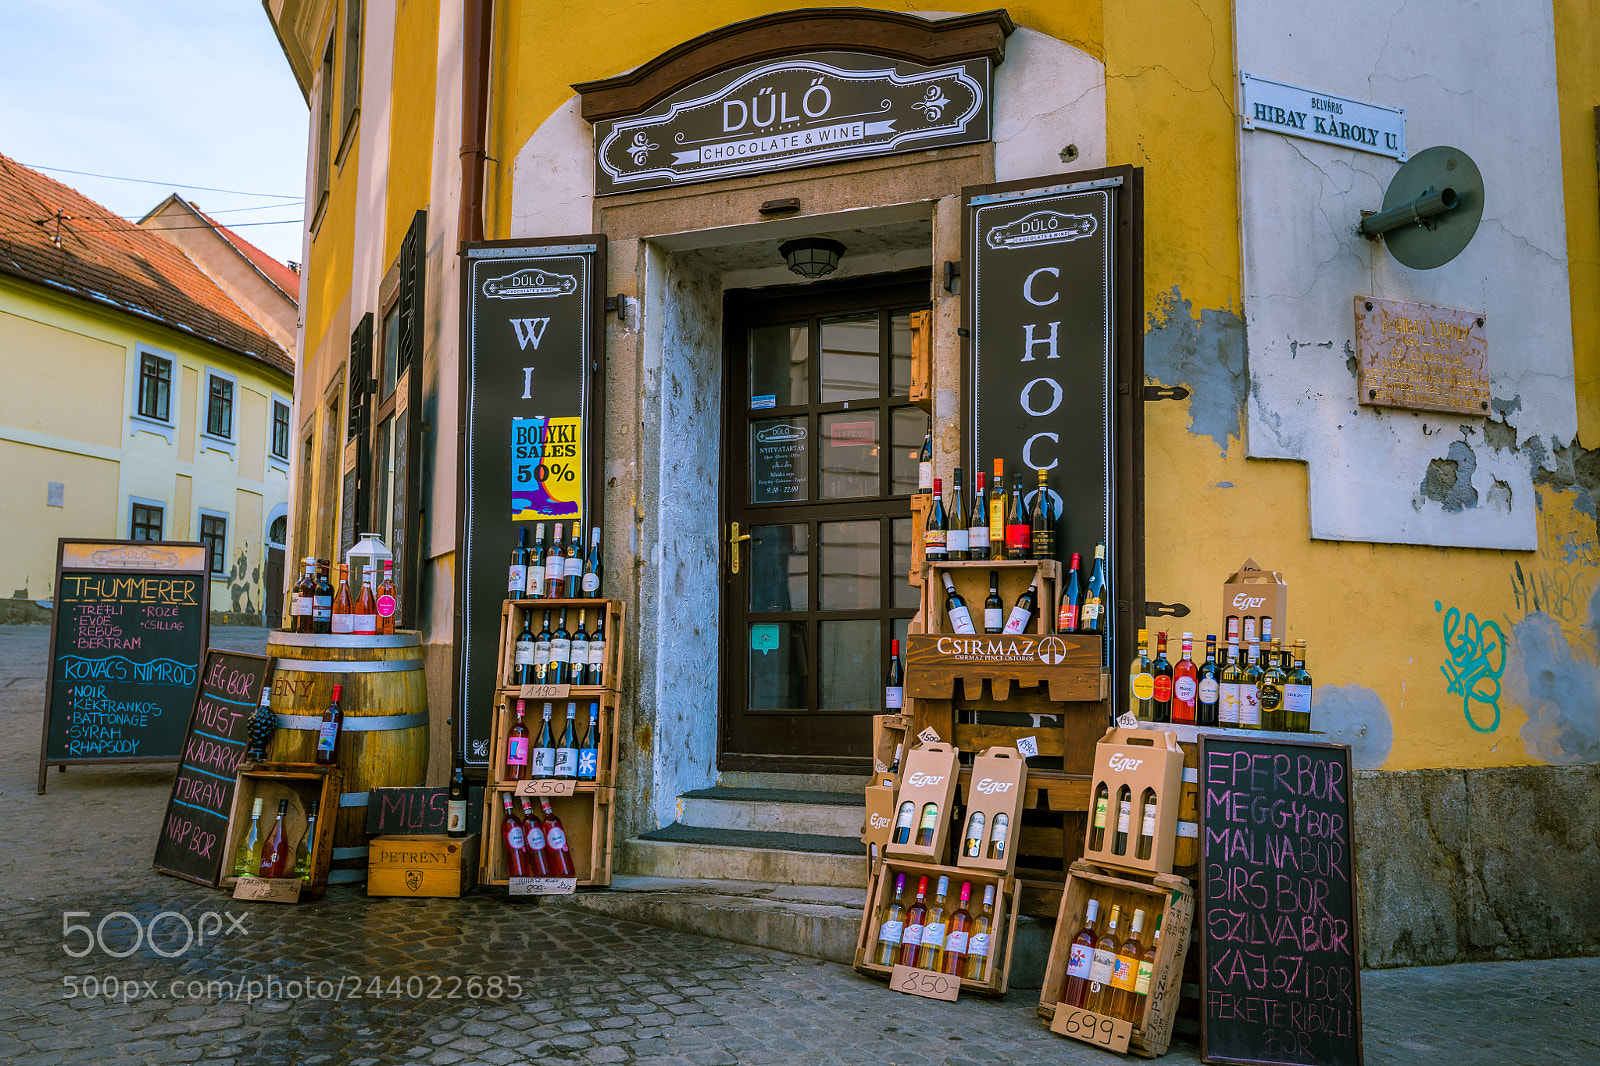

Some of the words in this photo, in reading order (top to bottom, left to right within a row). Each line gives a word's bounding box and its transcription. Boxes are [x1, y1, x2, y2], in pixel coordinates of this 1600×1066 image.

[722, 76, 833, 134] DŰLŐ
[1311, 97, 1344, 114] BELVÁROS
[1253, 103, 1308, 130] HIBAY
[1384, 132, 1398, 151] U.
[703, 134, 800, 161] CHOCOLATE
[804, 133, 814, 145] &
[818, 125, 862, 142] WINE
[1396, 317, 1426, 336] HIBAY
[509, 317, 551, 400] WI
[1020, 266, 1064, 524] CHOCO
[516, 424, 577, 445] BOLYKI
[516, 444, 576, 459] SALES
[516, 462, 576, 483] 50%
[63, 576, 198, 606] THUMMERER
[1232, 592, 1267, 611] Eger
[144, 620, 185, 631] CSILLAG
[77, 636, 142, 650] BERTRAM
[203, 657, 226, 689] JÉG
[226, 670, 256, 699] BOR
[73, 684, 108, 699] NOIR
[72, 712, 149, 727] BATTONAGE
[195, 698, 244, 737] MUST
[69, 725, 122, 740] SYRAH
[69, 739, 141, 756] RHAPSODY
[1108, 752, 1144, 772] Eger
[908, 771, 945, 788] Eger
[976, 778, 1013, 795] Eger
[378, 792, 474, 830] MUS
[869, 812, 892, 830] Eger
[165, 813, 192, 844] NAP
[188, 826, 217, 860] BOR
[379, 848, 451, 864] PETRÉNY
[1207, 862, 1269, 910] BIRS
[1276, 873, 1334, 920] BOR
[1262, 1027, 1316, 1060] BOR
